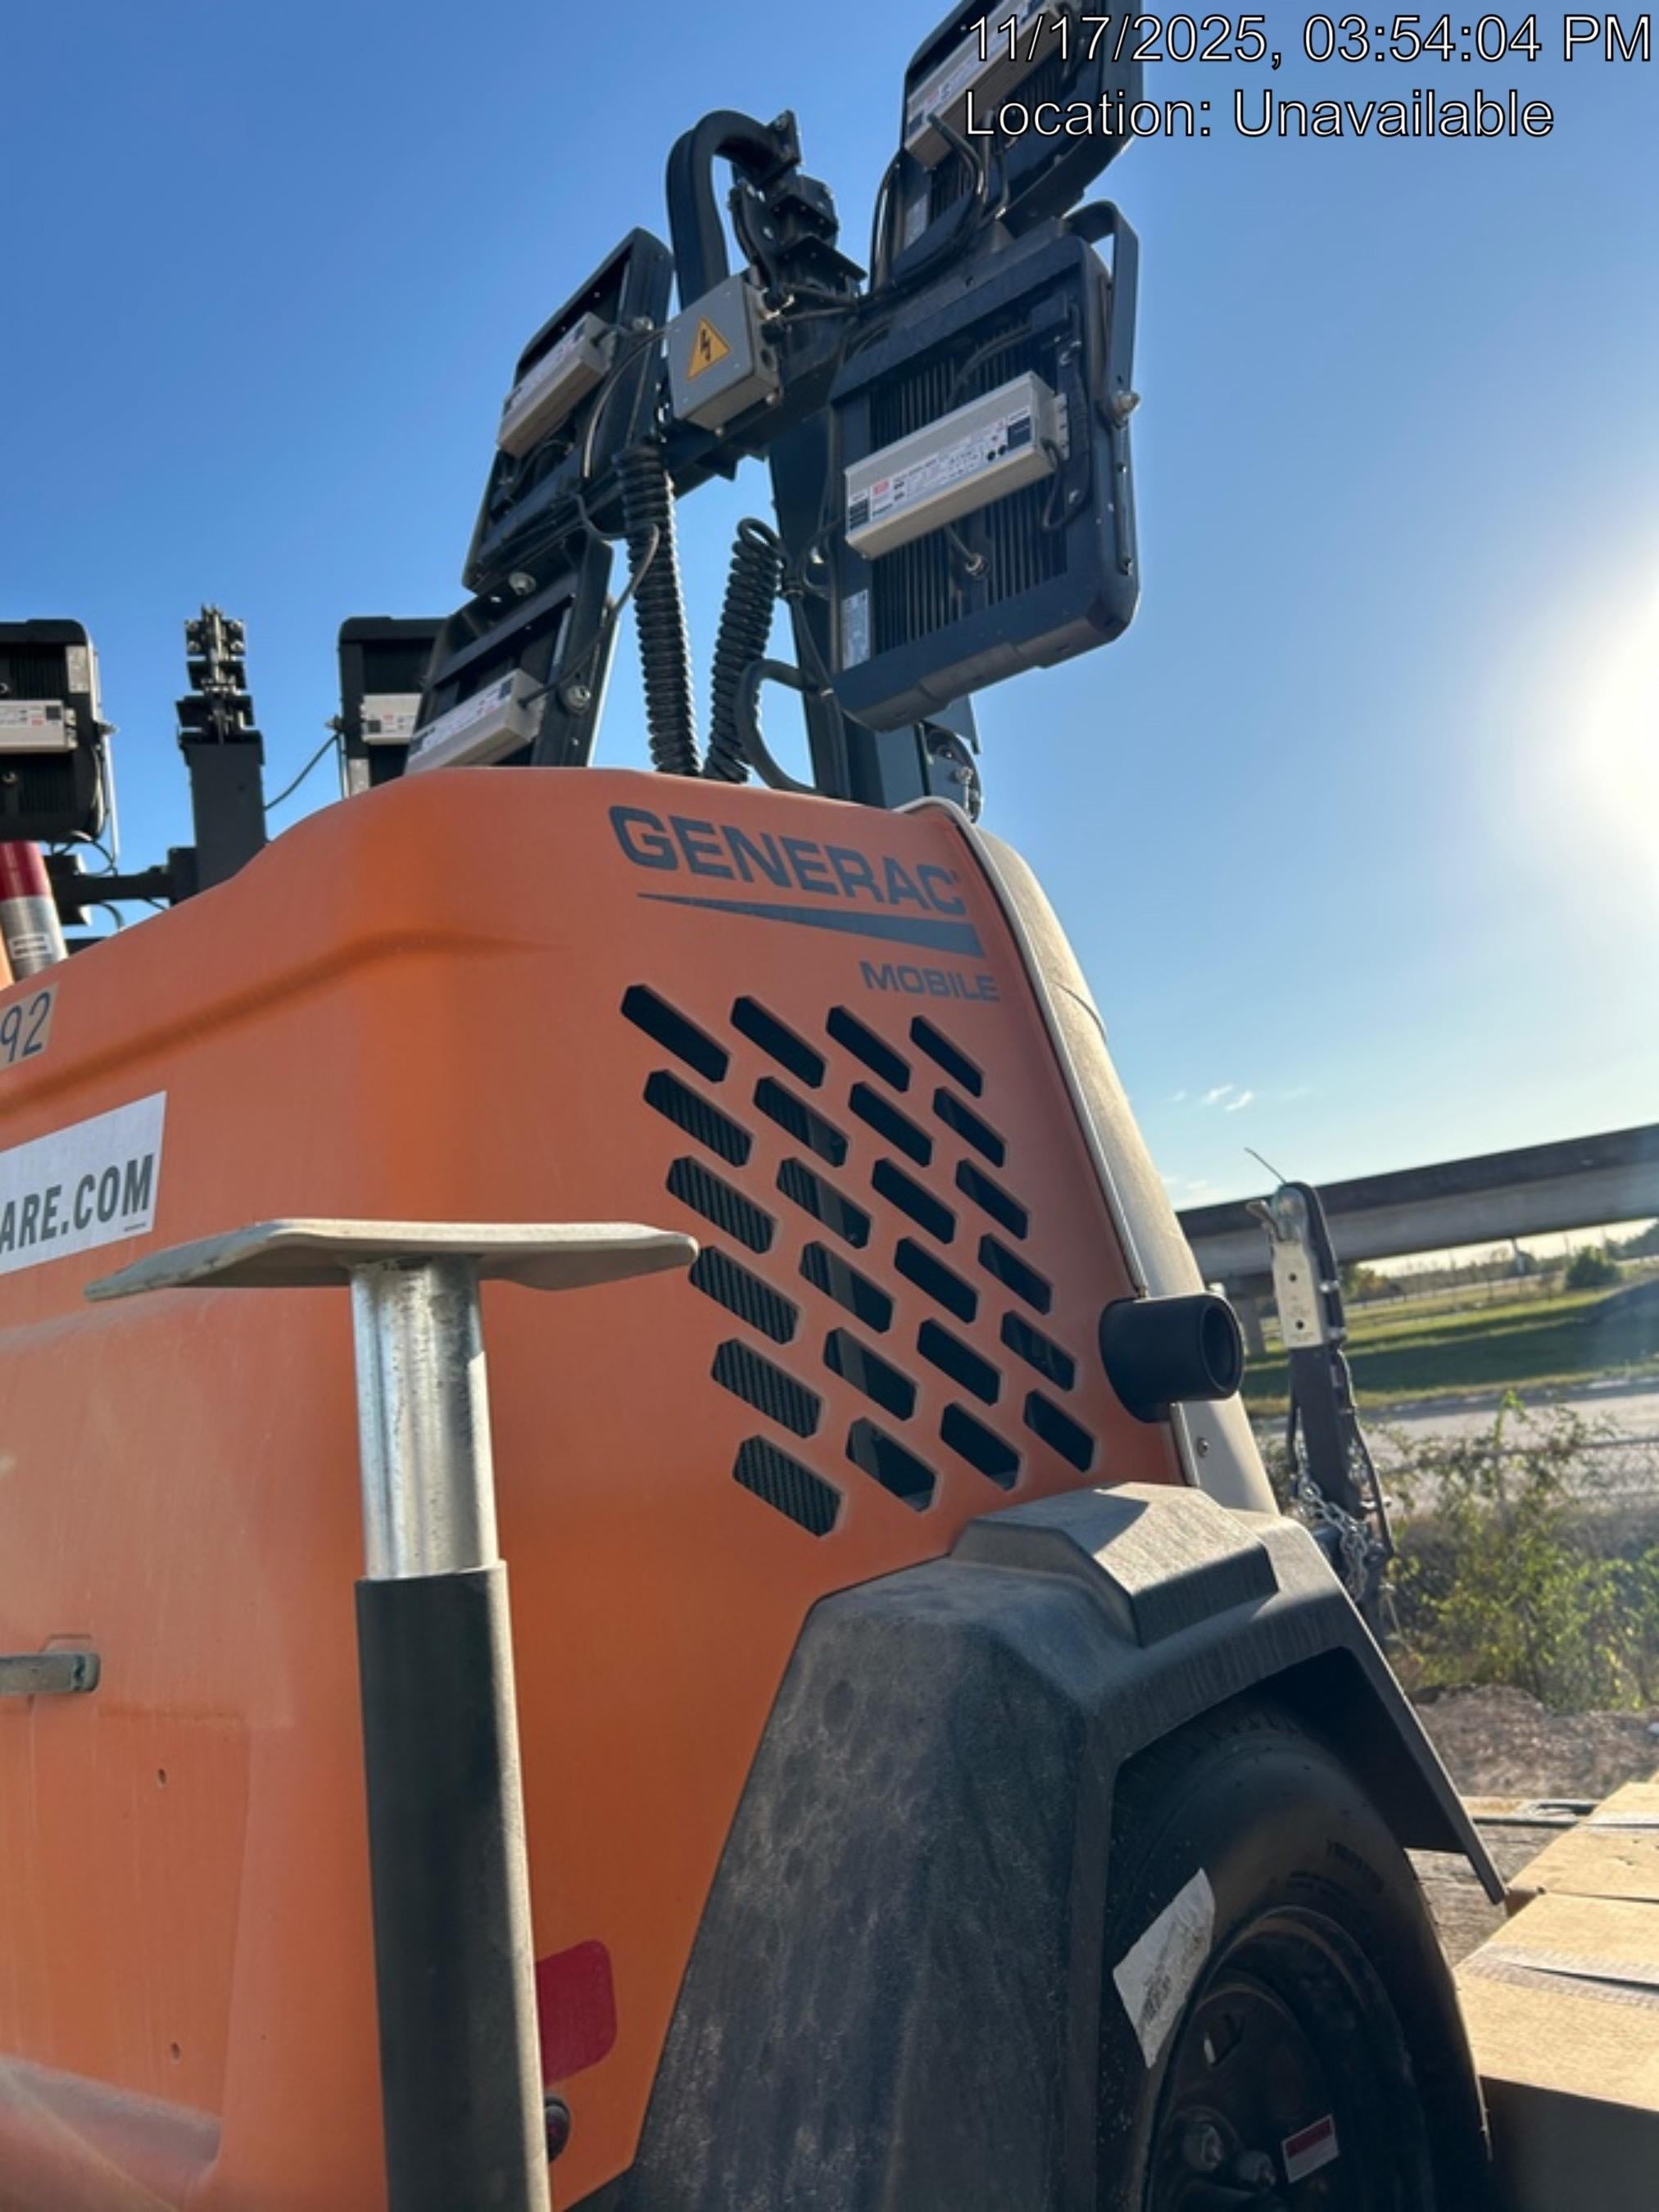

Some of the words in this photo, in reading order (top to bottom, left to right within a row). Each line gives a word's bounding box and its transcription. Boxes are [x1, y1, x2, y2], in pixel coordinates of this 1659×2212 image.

[609, 805, 968, 916] GENERAC
[859, 960, 999, 1002] MOBILE
[0, 991, 51, 1063] 92
[0, 1154, 155, 1254] ARE.COM
